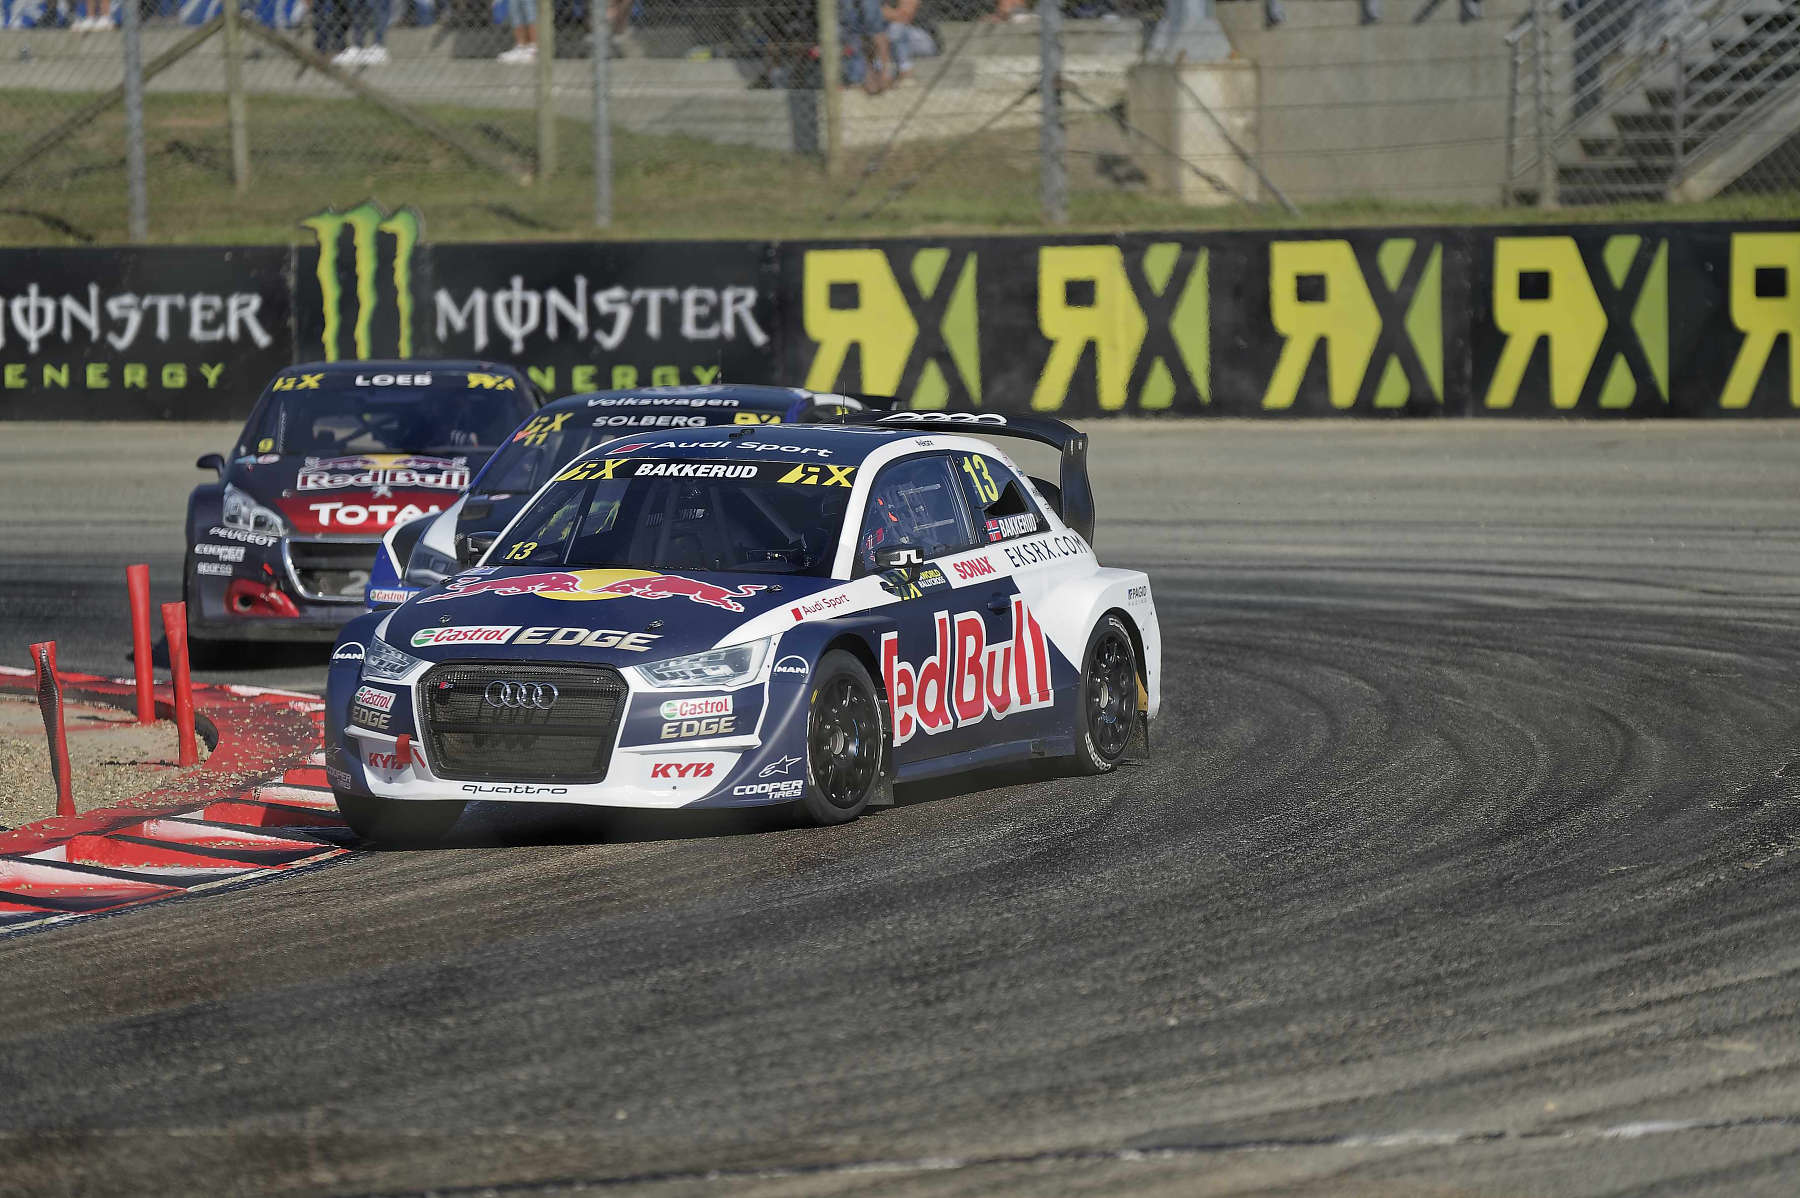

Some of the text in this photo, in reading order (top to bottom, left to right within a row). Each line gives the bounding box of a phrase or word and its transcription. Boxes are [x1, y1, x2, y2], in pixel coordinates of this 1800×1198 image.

[0, 282, 272, 355] ONSTER
[434, 274, 770, 355] MONSTER
[3, 362, 224, 390] ENERGY
[355, 374, 433, 387] LOEB
[527, 364, 720, 392] NERGY
[587, 398, 740, 408] Volkswagen
[592, 415, 707, 428] SOLBERG
[651, 441, 833, 457] Audi Sport
[297, 468, 470, 491] Red Bull
[634, 463, 758, 479] BAKKERUD
[962, 454, 999, 503] 13
[999, 513, 1037, 537] BAKKERUD
[209, 526, 277, 547] PEUGEOT
[504, 541, 538, 560] 13
[1003, 535, 1088, 568] EKSRX.COM
[953, 556, 997, 580] SONAX
[376, 591, 405, 601] Castrol
[802, 593, 850, 616] Audi Sport
[434, 627, 511, 643] Castrol
[512, 626, 664, 652] EDGE
[335, 652, 363, 660] MAN
[953, 593, 1054, 729] Bull
[776, 666, 807, 674] MAN
[361, 689, 392, 709] Castrol
[679, 697, 729, 717] Castrol
[352, 706, 392, 730] EDGE
[660, 716, 738, 739] EDGE
[651, 762, 715, 779] KYB
[462, 784, 568, 795] quattro
[733, 779, 804, 796] COOPER
[768, 789, 802, 800] TIRES
